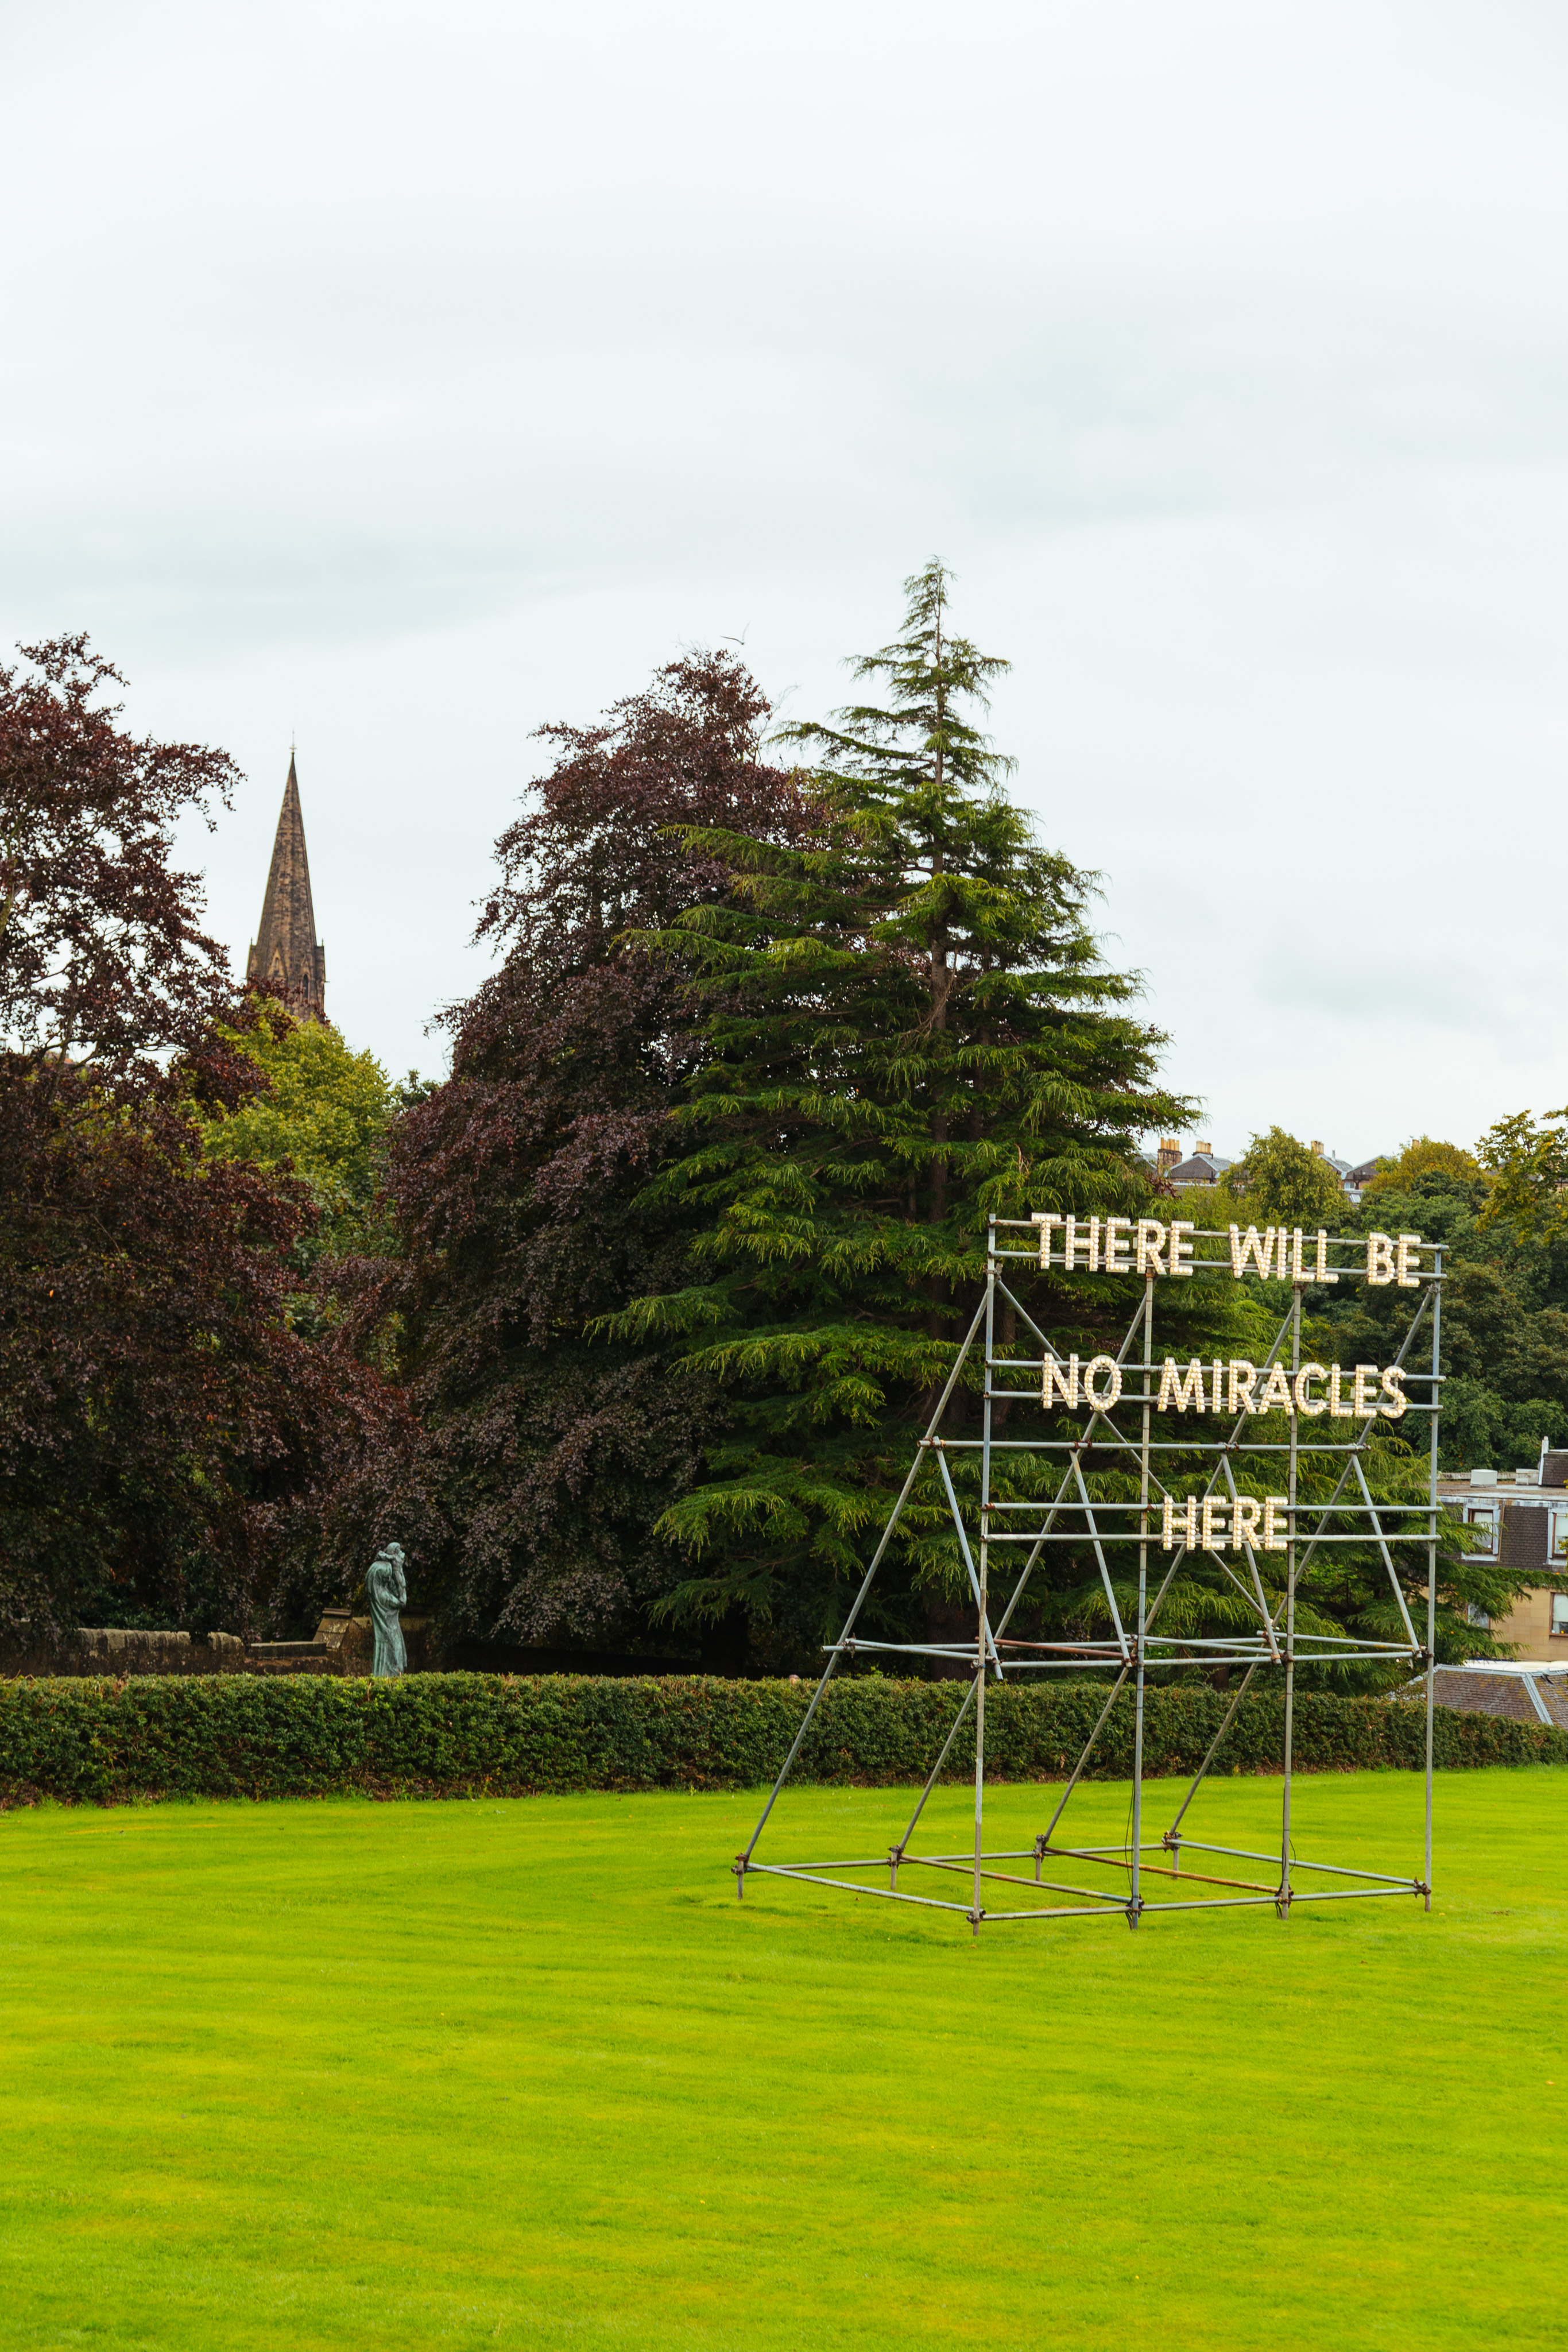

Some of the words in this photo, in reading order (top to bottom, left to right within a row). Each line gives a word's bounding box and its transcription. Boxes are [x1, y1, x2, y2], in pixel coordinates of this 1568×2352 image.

[1031, 1212, 1194, 1276] THERE
[1229, 1224, 1339, 1283] WILL
[1367, 1232, 1422, 1287] BE
[1043, 1352, 1122, 1411] NO
[1157, 1357, 1407, 1419] MIRACLES
[1163, 1495, 1288, 1550] HERE
